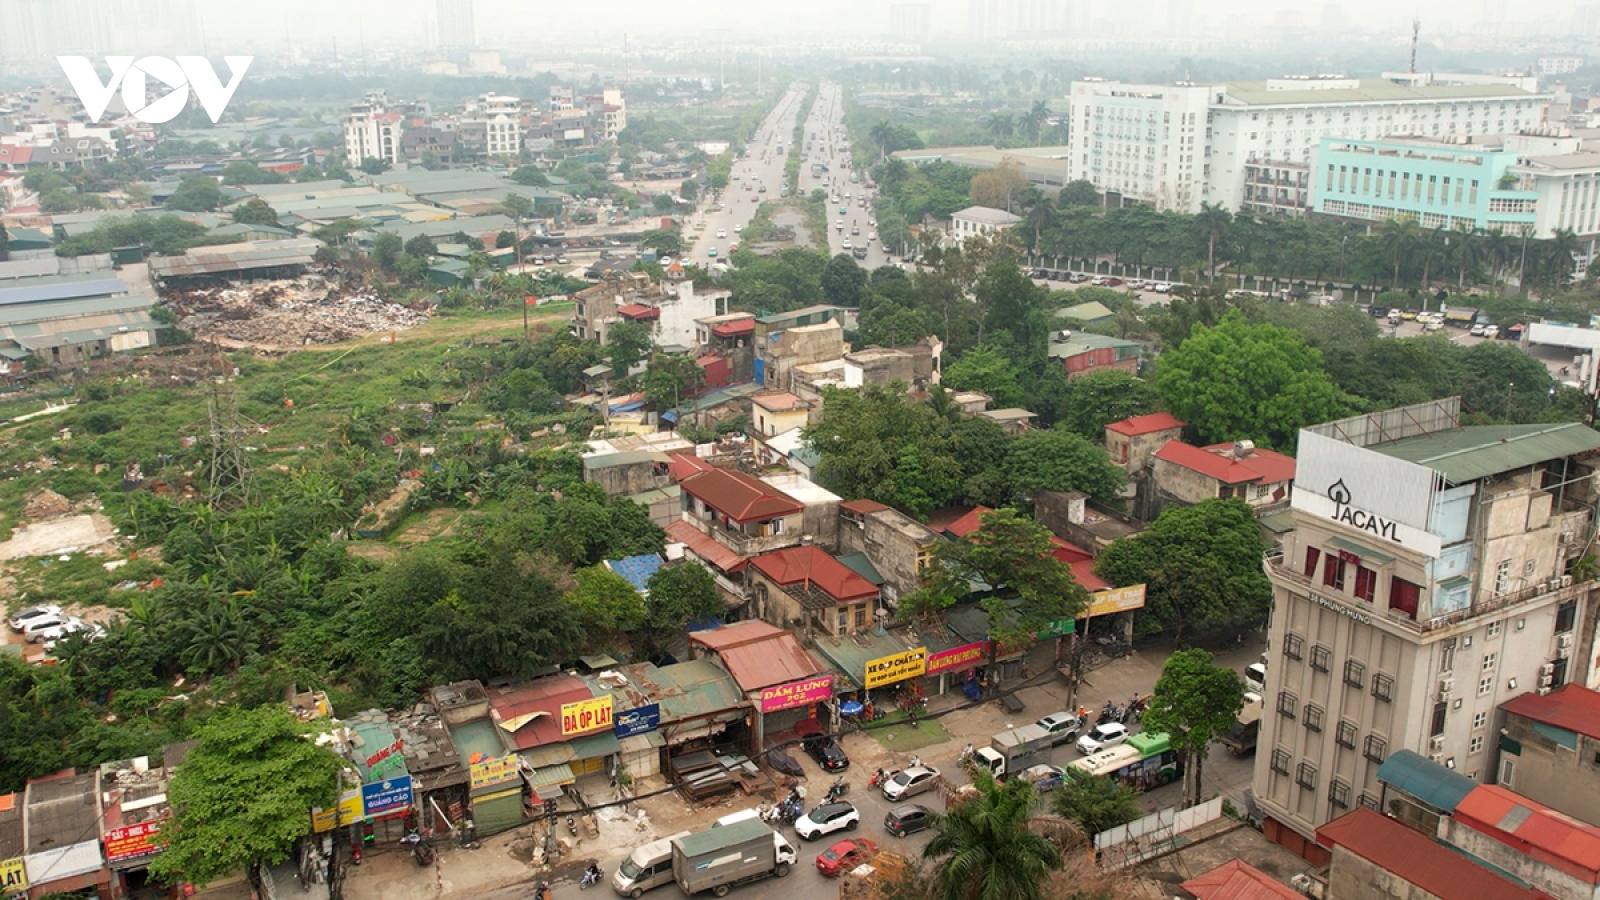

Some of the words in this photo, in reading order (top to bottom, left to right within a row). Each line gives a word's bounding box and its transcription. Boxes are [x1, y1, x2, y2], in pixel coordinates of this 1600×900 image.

[1331, 489, 1402, 543] JACAYL
[563, 711, 578, 733] ĐÁ
[594, 703, 612, 725] LÁT
